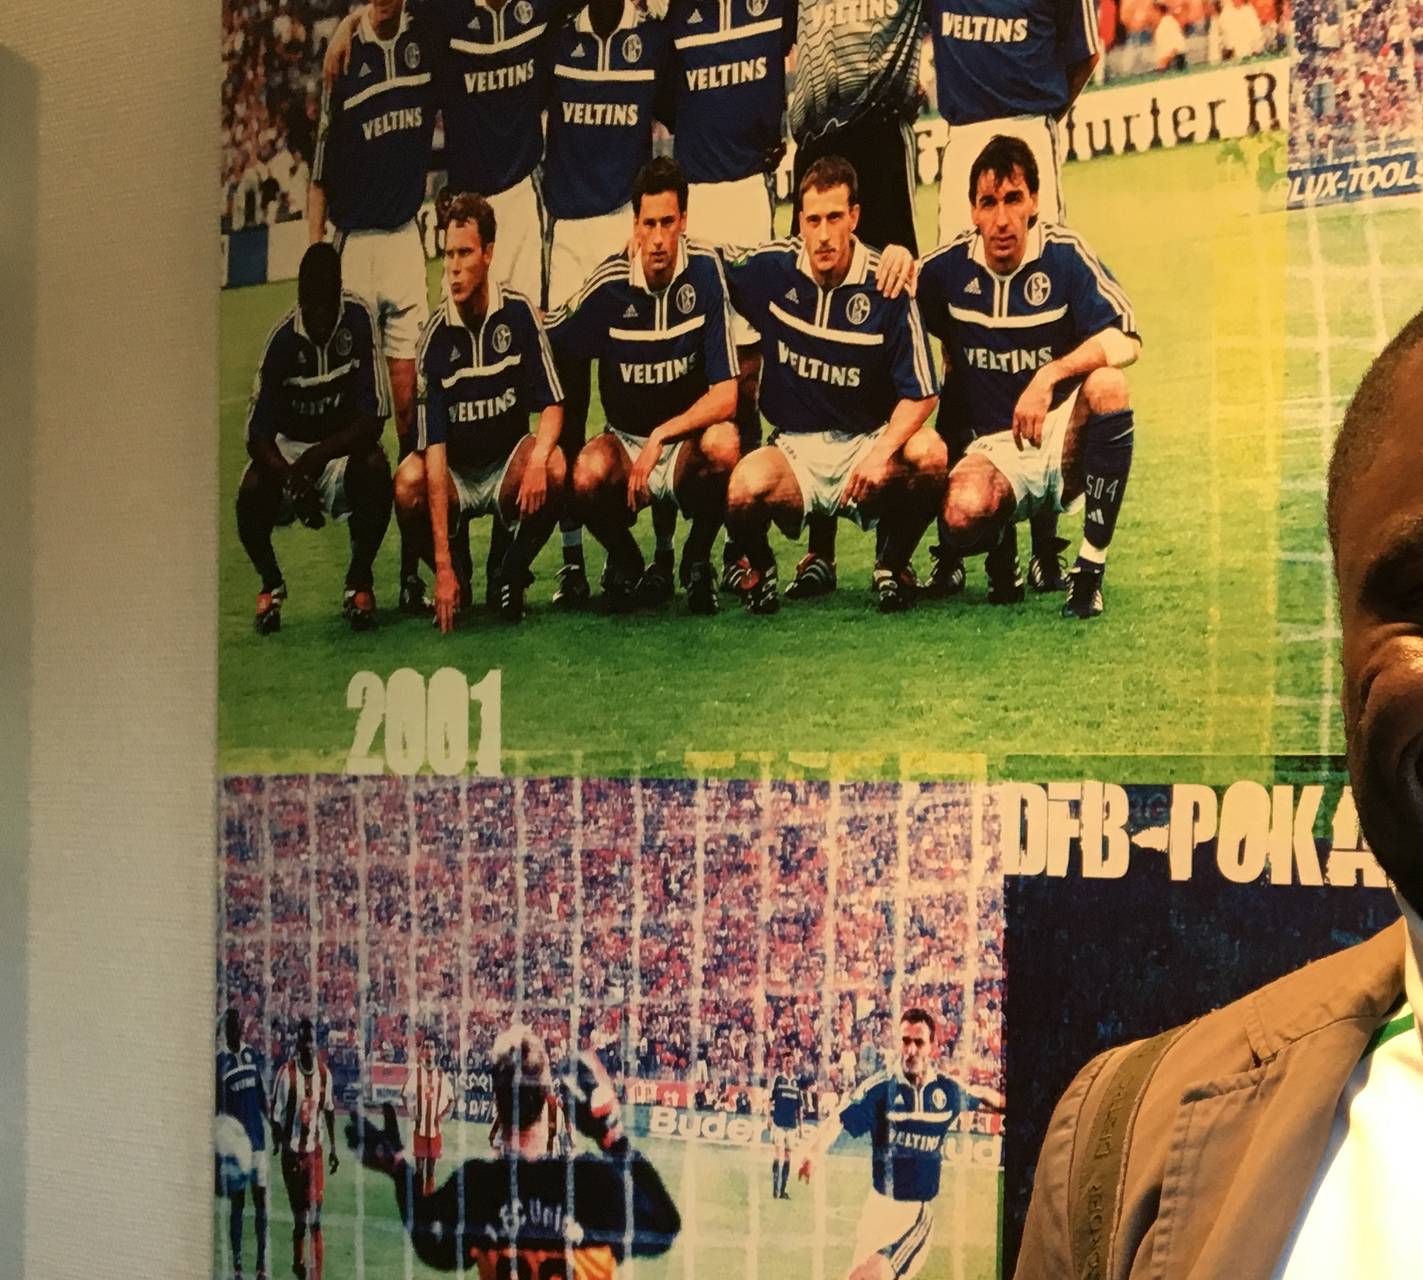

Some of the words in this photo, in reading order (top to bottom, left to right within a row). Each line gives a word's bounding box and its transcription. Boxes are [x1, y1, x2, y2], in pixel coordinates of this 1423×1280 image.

[941, 11, 1028, 43] VELTINS
[463, 58, 535, 95] VELTINS
[685, 56, 767, 91] VELTINS
[361, 106, 423, 141] VELTINS
[562, 101, 639, 127] VELTINS
[619, 352, 697, 385] VELTINS
[777, 340, 861, 388] VELTINS
[963, 345, 1053, 374] VELTINS
[448, 387, 517, 424] VELTINS
[345, 667, 502, 777] 2001
[652, 1105, 826, 1151] Buders
[889, 1128, 941, 1152] VELTIN
